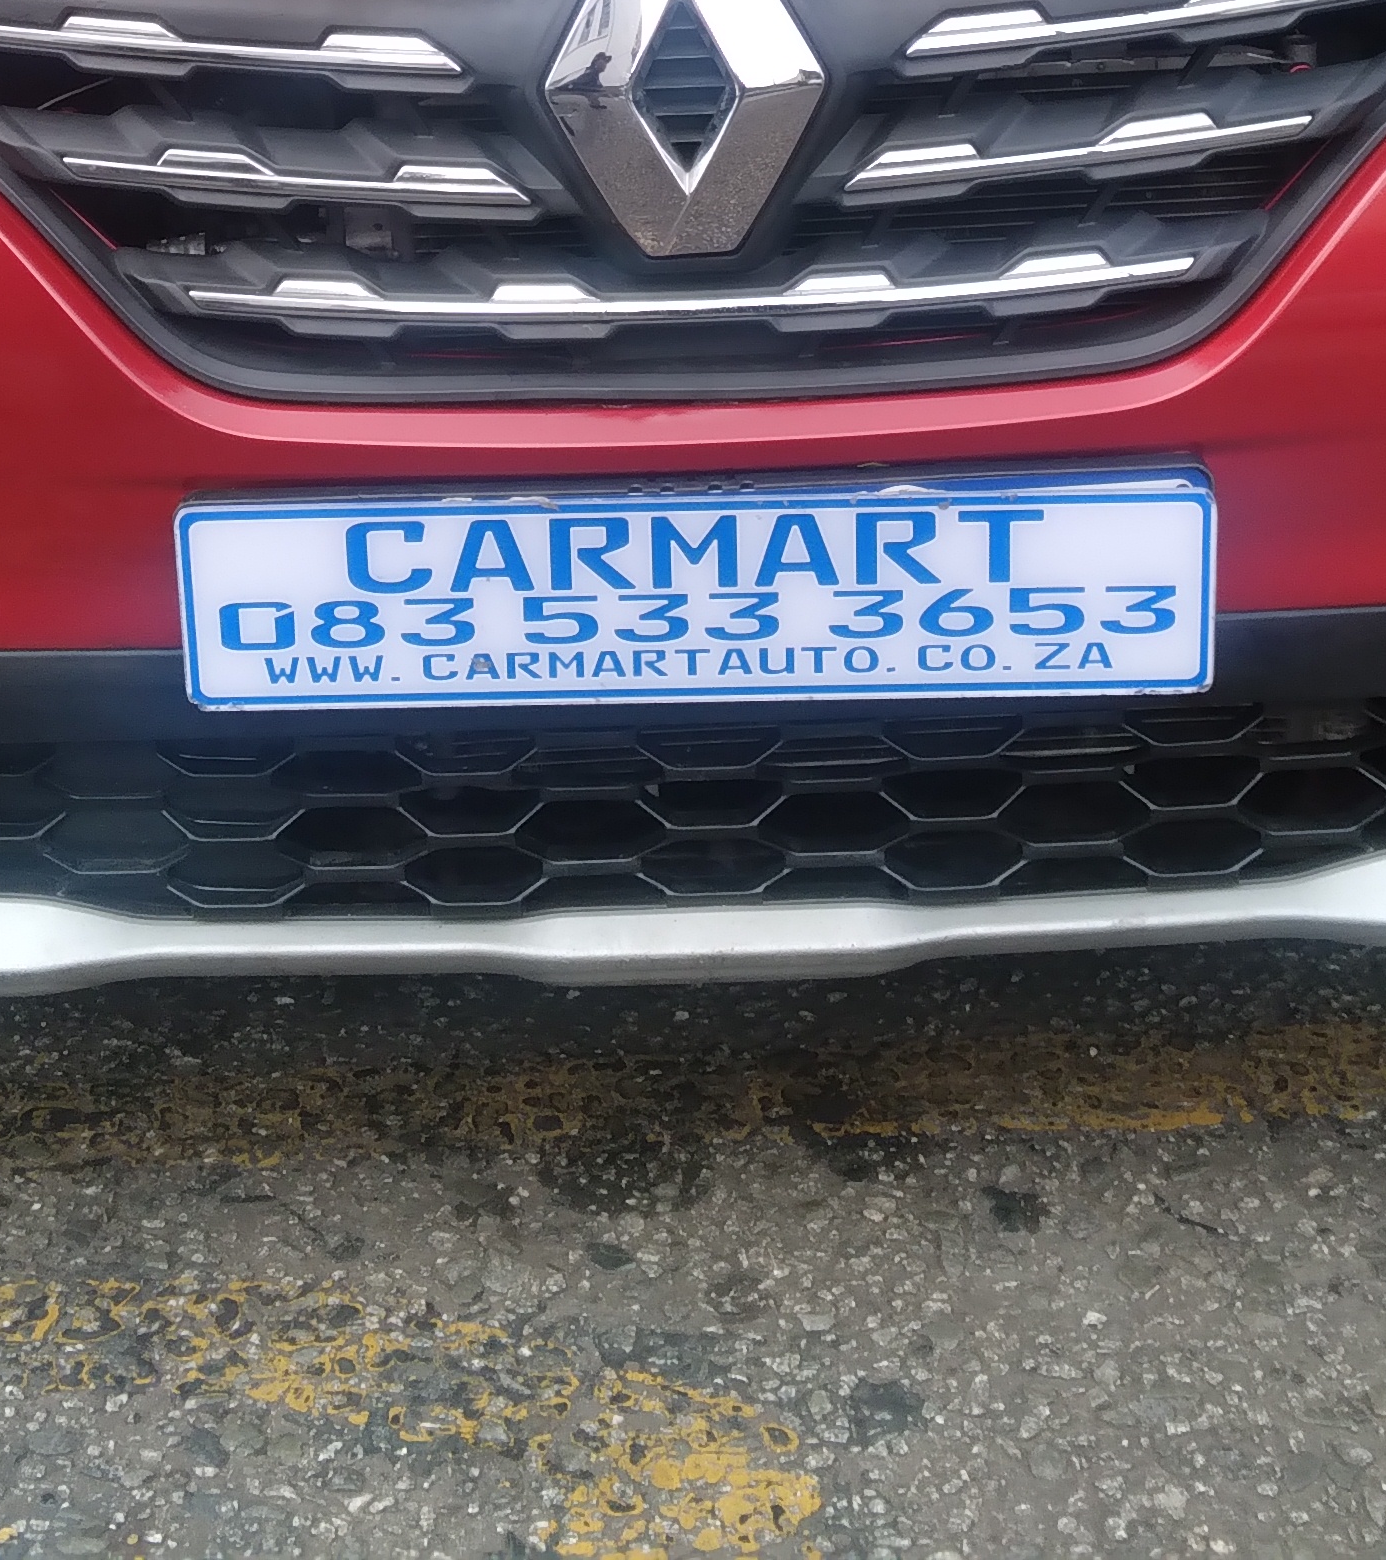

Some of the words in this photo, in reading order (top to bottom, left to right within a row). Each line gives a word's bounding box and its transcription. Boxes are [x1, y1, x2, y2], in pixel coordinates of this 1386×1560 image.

[343, 507, 1045, 596] CARMART
[217, 596, 476, 653] 083
[521, 591, 779, 647] 533
[831, 584, 1176, 639] 3653
